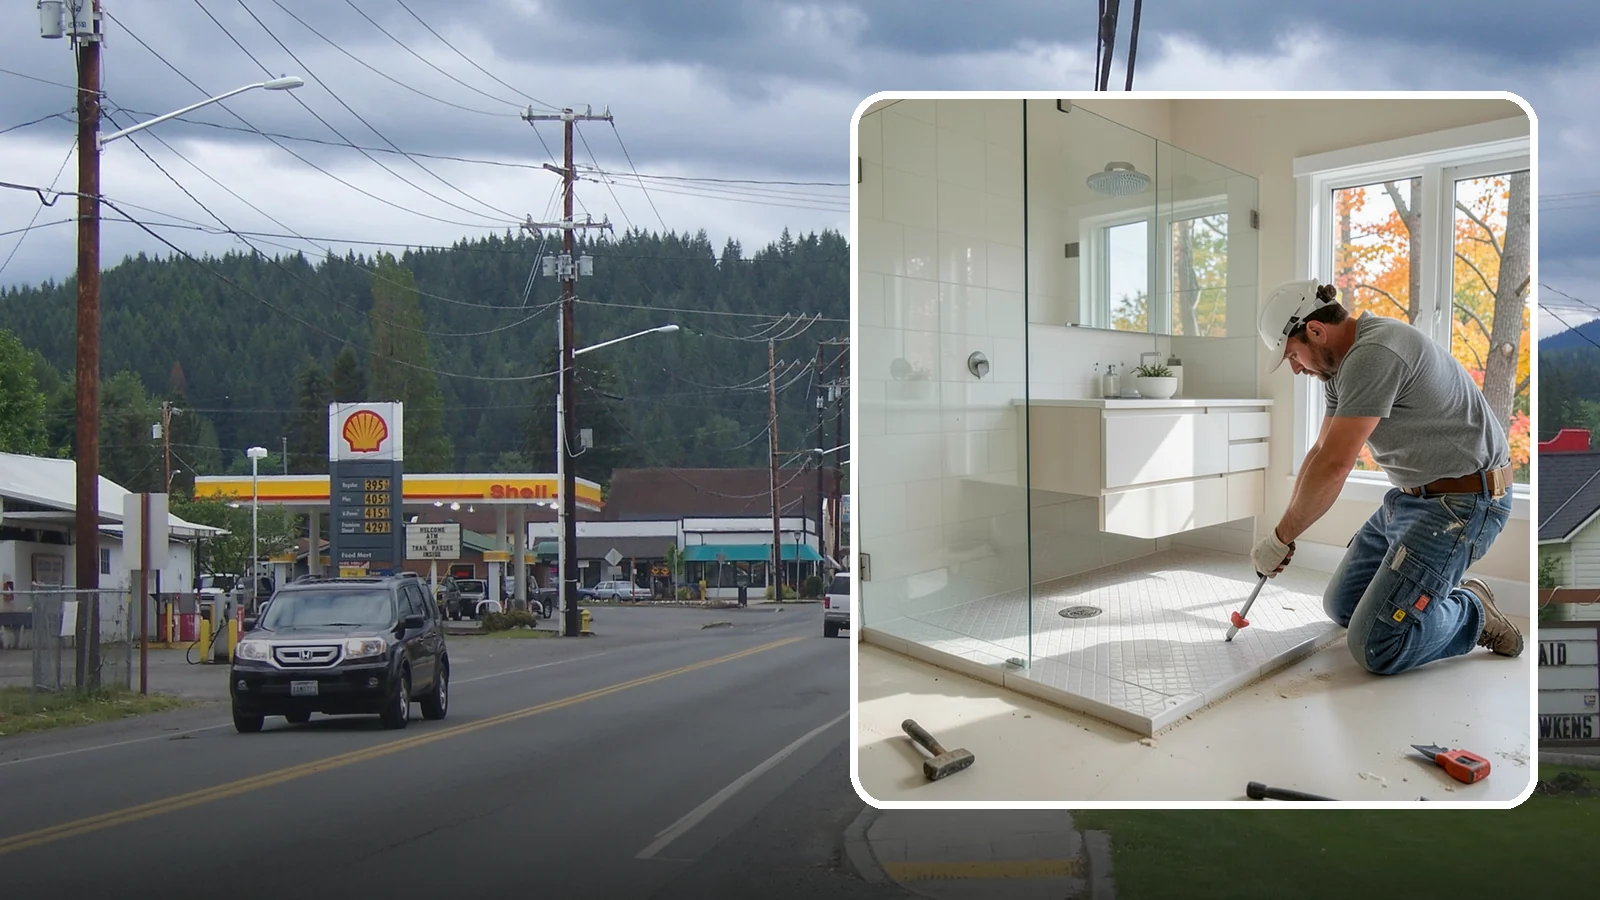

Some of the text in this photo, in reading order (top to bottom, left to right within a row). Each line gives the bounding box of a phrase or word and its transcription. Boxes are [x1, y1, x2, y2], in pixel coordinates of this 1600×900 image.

[365, 480, 383, 490] 395
[490, 484, 547, 499] Shell
[365, 494, 383, 504] 405
[365, 508, 383, 518] 415
[365, 522, 383, 533] 429
